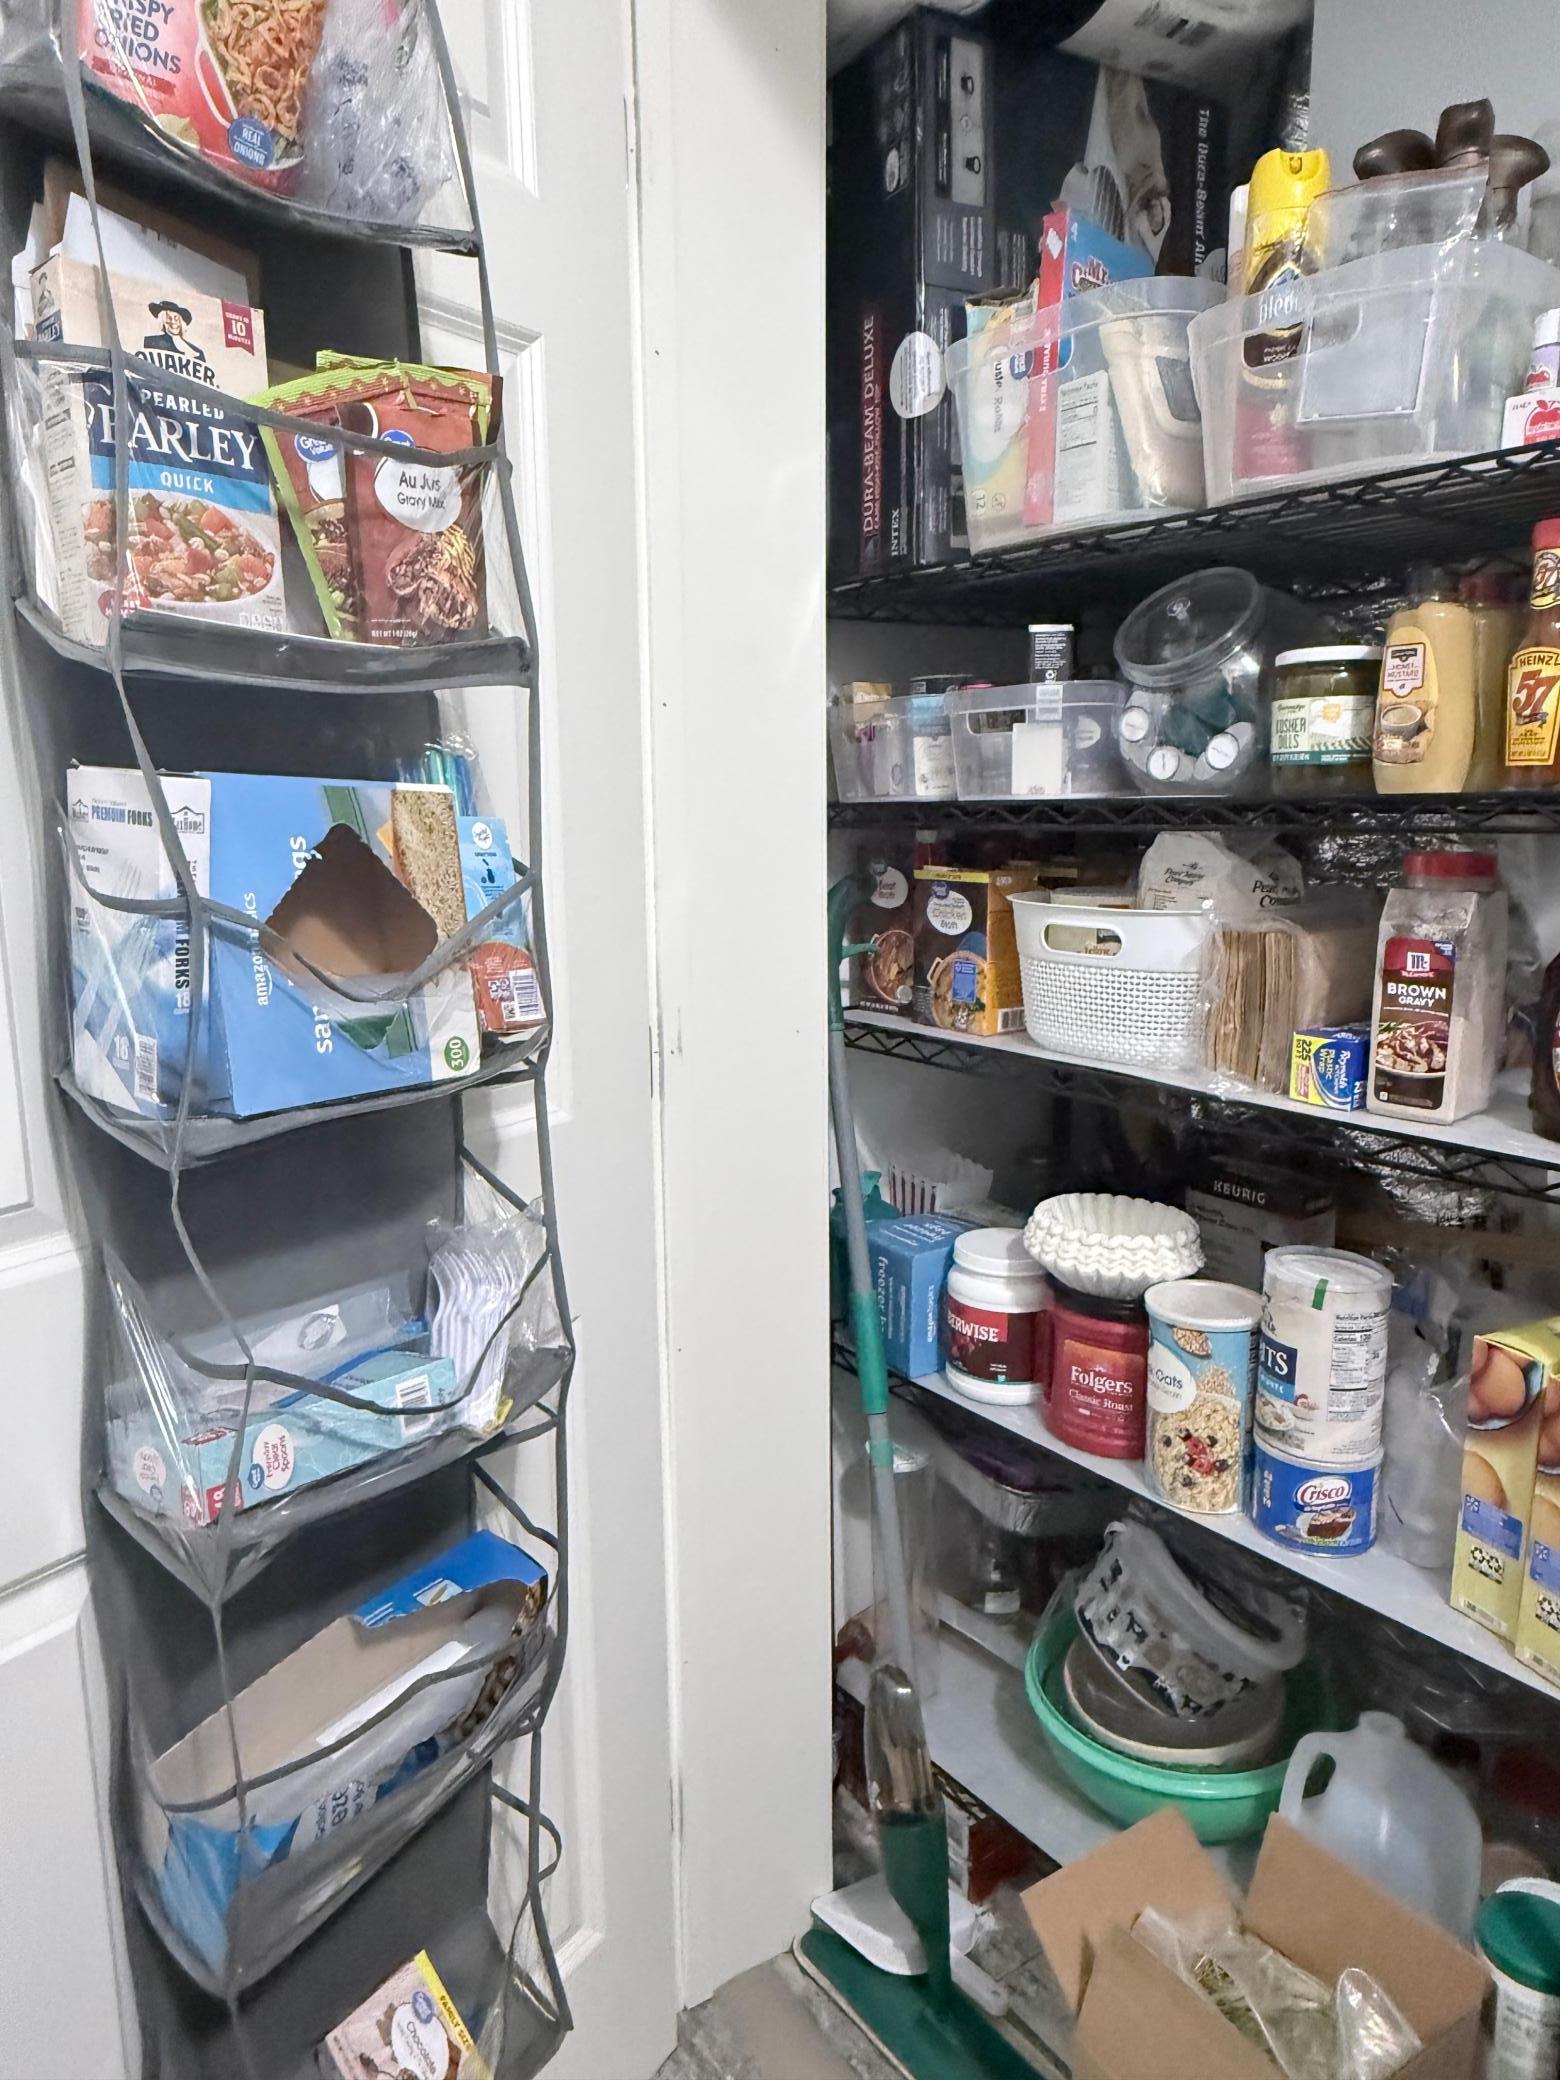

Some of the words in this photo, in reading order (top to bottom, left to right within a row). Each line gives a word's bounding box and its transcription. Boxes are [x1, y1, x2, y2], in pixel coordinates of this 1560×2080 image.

[108, 0, 175, 24] ISPY
[105, 7, 160, 42] RIED
[1259, 291, 1299, 326] pled
[231, 319, 246, 337] 10
[863, 315, 875, 400] DELUXE
[141, 388, 225, 420] PEARLED
[160, 471, 214, 494] QUICK
[399, 471, 417, 489] Au
[420, 473, 442, 492] Jus
[397, 492, 426, 510] Gravy
[891, 508, 900, 556] INTEX
[1519, 653, 1554, 667] HEINZ
[1512, 669, 1560, 716] 57
[127, 809, 153, 828] FORKS
[175, 938, 190, 990] FORKS
[1387, 982, 1447, 1000] BROWN
[1398, 996, 1435, 1008] GRAVY
[449, 1038, 465, 1070] 300
[1301, 1039, 1312, 1061] 225
[1212, 1179, 1267, 1205] KEURIG
[1070, 1365, 1133, 1394] Folgers
[1155, 1368, 1183, 1390] Oats
[1102, 1398, 1134, 1413] Roast
[279, 1434, 291, 1472] Spoons
[1300, 1484, 1346, 1506] Crisco
